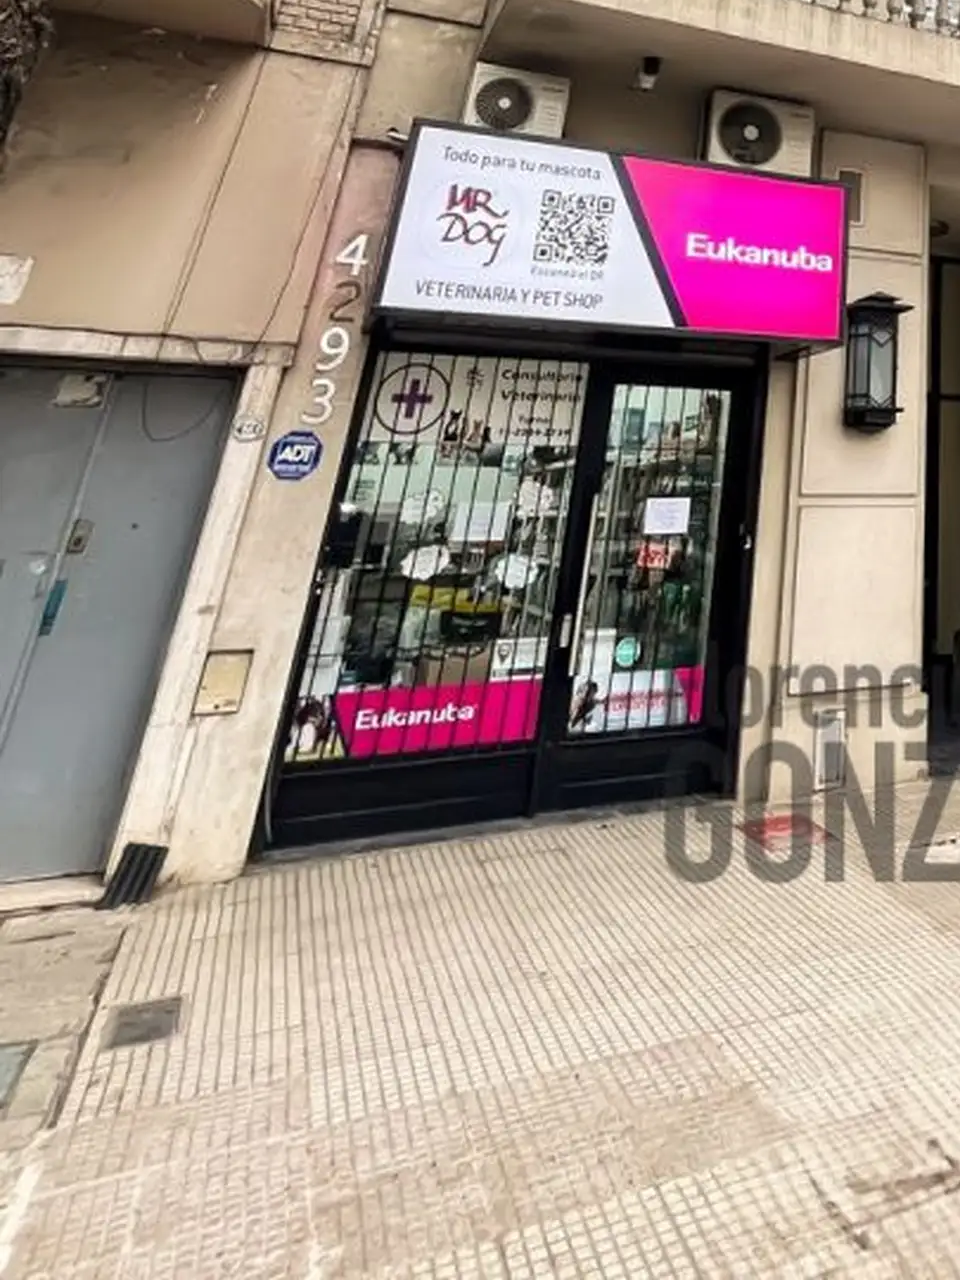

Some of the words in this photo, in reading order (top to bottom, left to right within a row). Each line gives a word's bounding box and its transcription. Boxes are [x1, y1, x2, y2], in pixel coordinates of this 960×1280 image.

[443, 146, 478, 164] Todo
[480, 153, 517, 170] para
[520, 159, 535, 172] tu
[538, 162, 602, 181] mascota
[686, 231, 833, 272] Eukanuba
[415, 279, 517, 302] VETERINARIA
[520, 290, 531, 304] Y
[533, 291, 561, 307] PET
[562, 292, 604, 309] SHOP
[301, 234, 369, 424] 4293
[277, 444, 317, 463] ADT
[355, 702, 475, 731] Eukanuba
